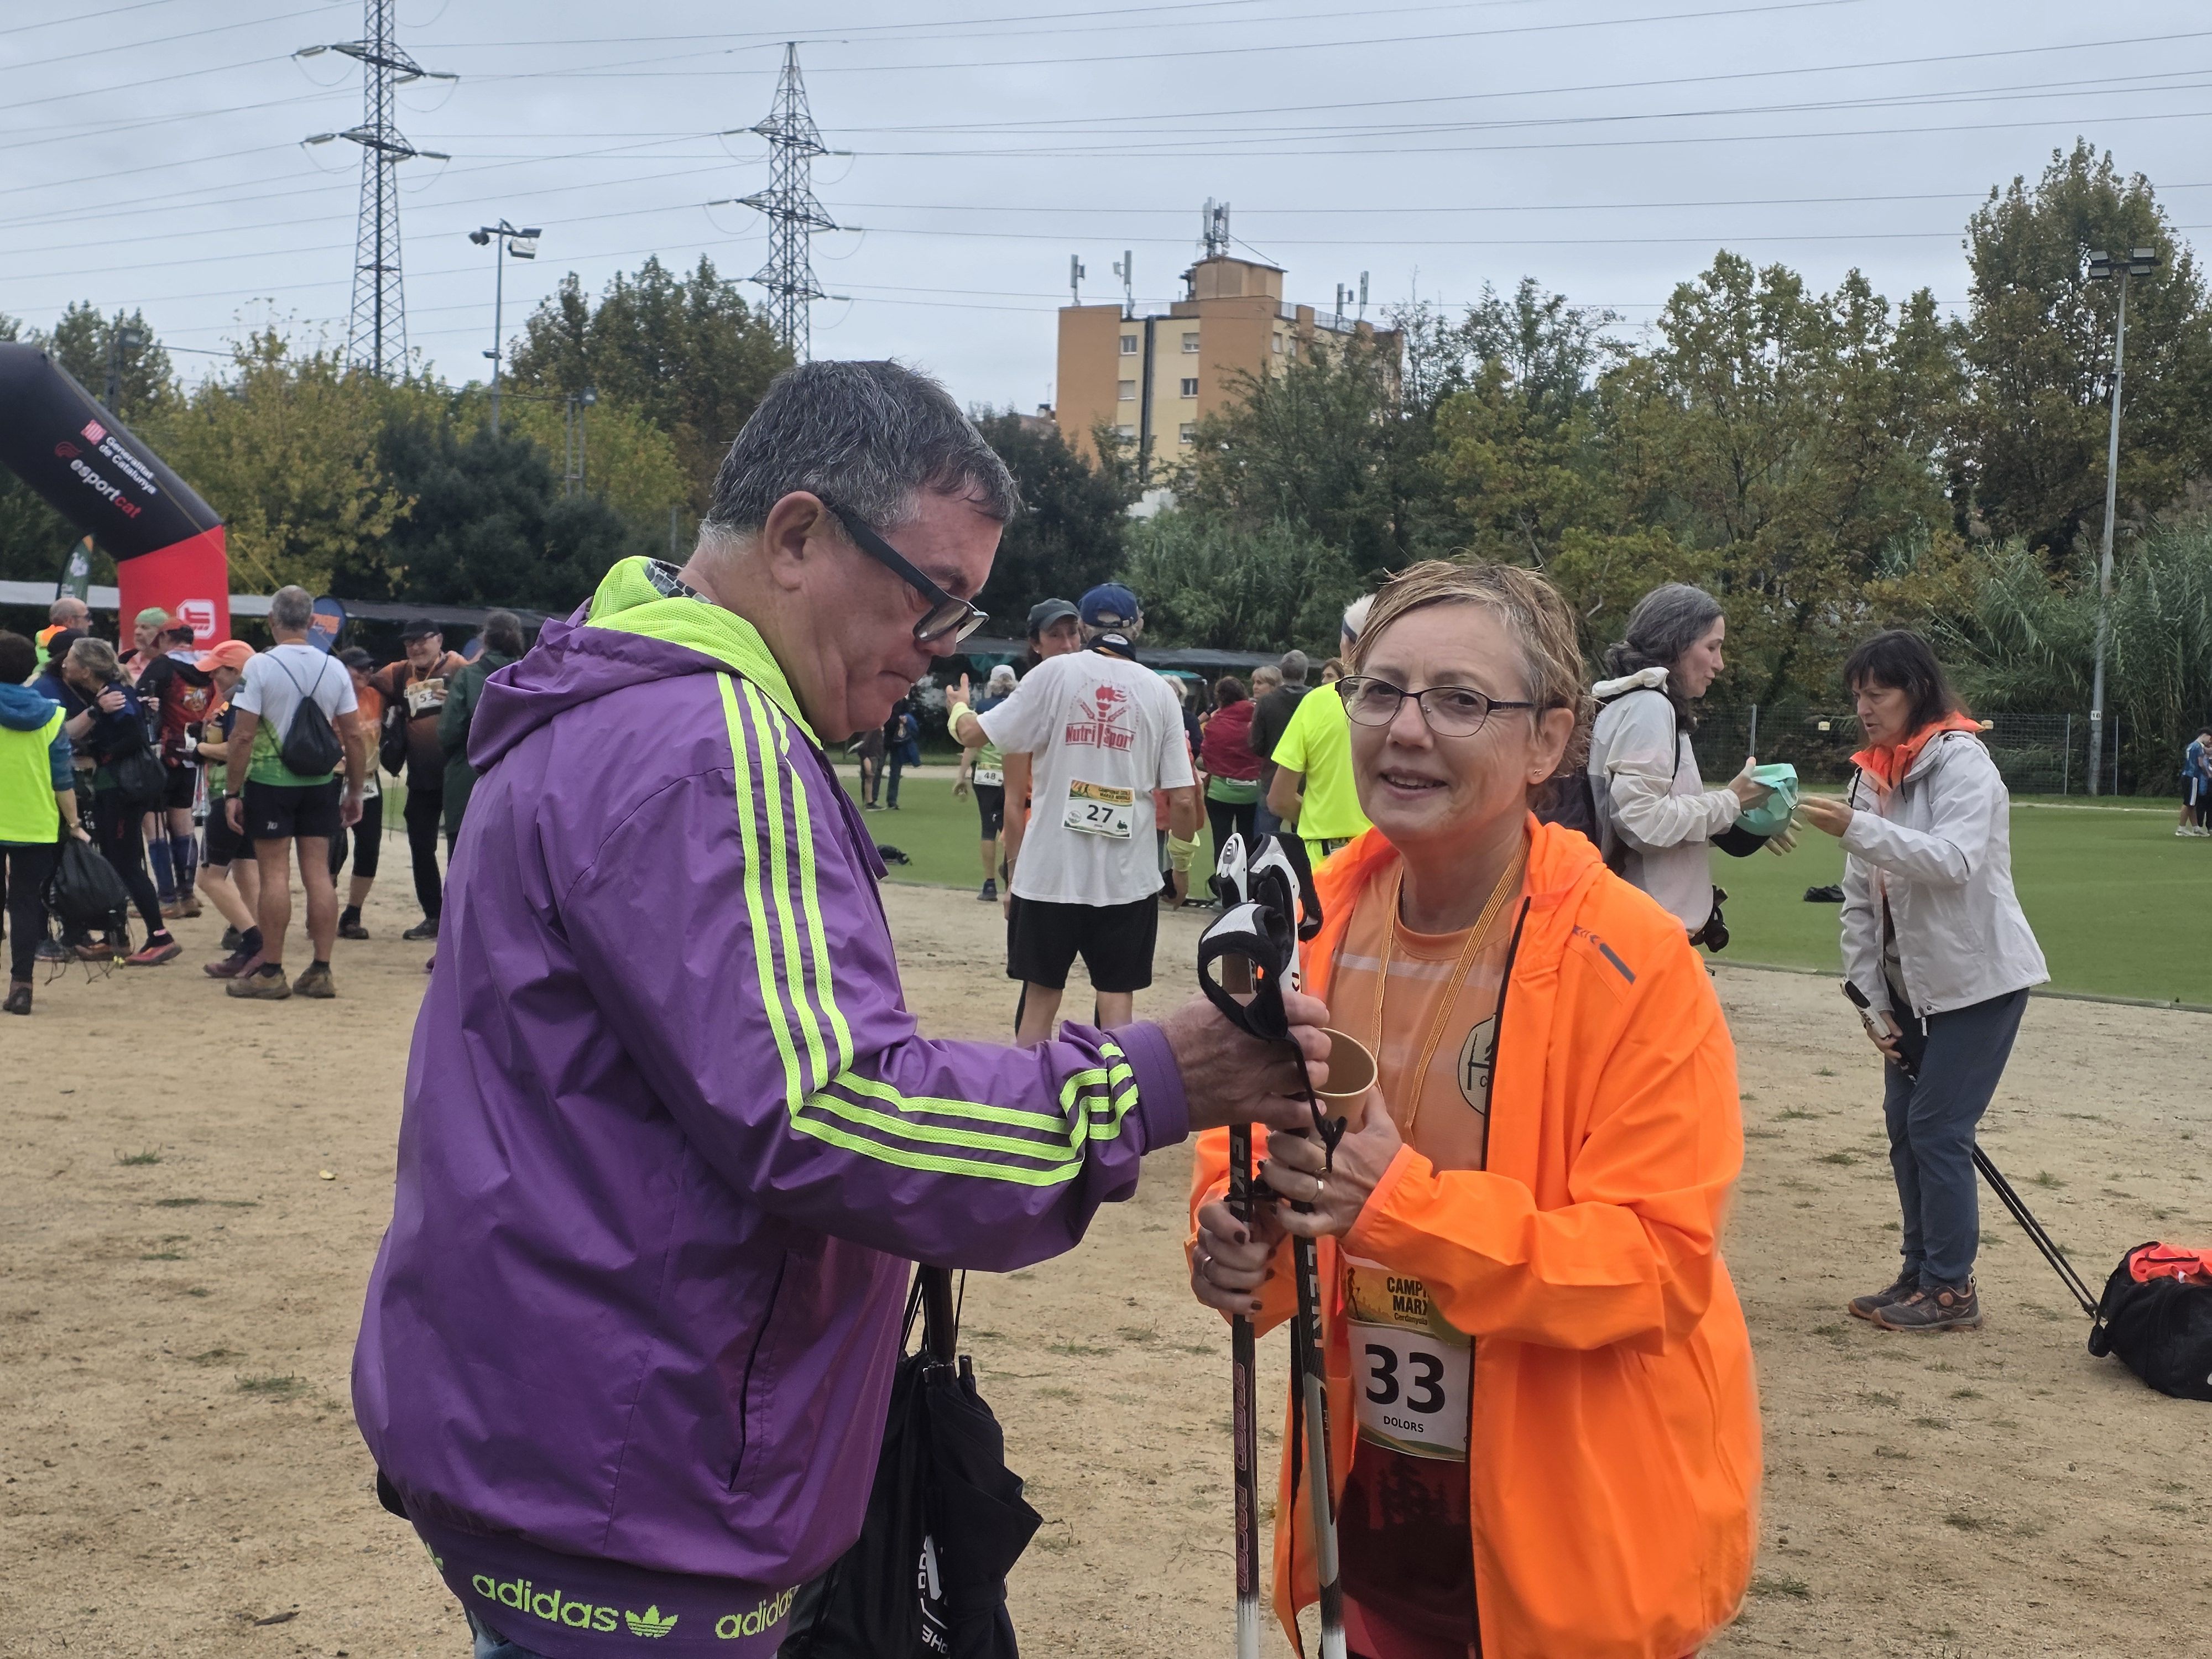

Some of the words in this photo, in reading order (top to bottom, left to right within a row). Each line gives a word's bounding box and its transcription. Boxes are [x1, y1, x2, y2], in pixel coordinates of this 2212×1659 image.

[98, 444, 113, 457] de
[112, 455, 157, 494] Catalunya
[1087, 805, 1113, 823] 27
[1365, 1344, 1446, 1413] 33
[1234, 1362, 1248, 1472] SPEED
[1384, 1416, 1424, 1433] DOLORS
[1235, 1484, 1250, 1593] PACER
[472, 1574, 619, 1632] adidas
